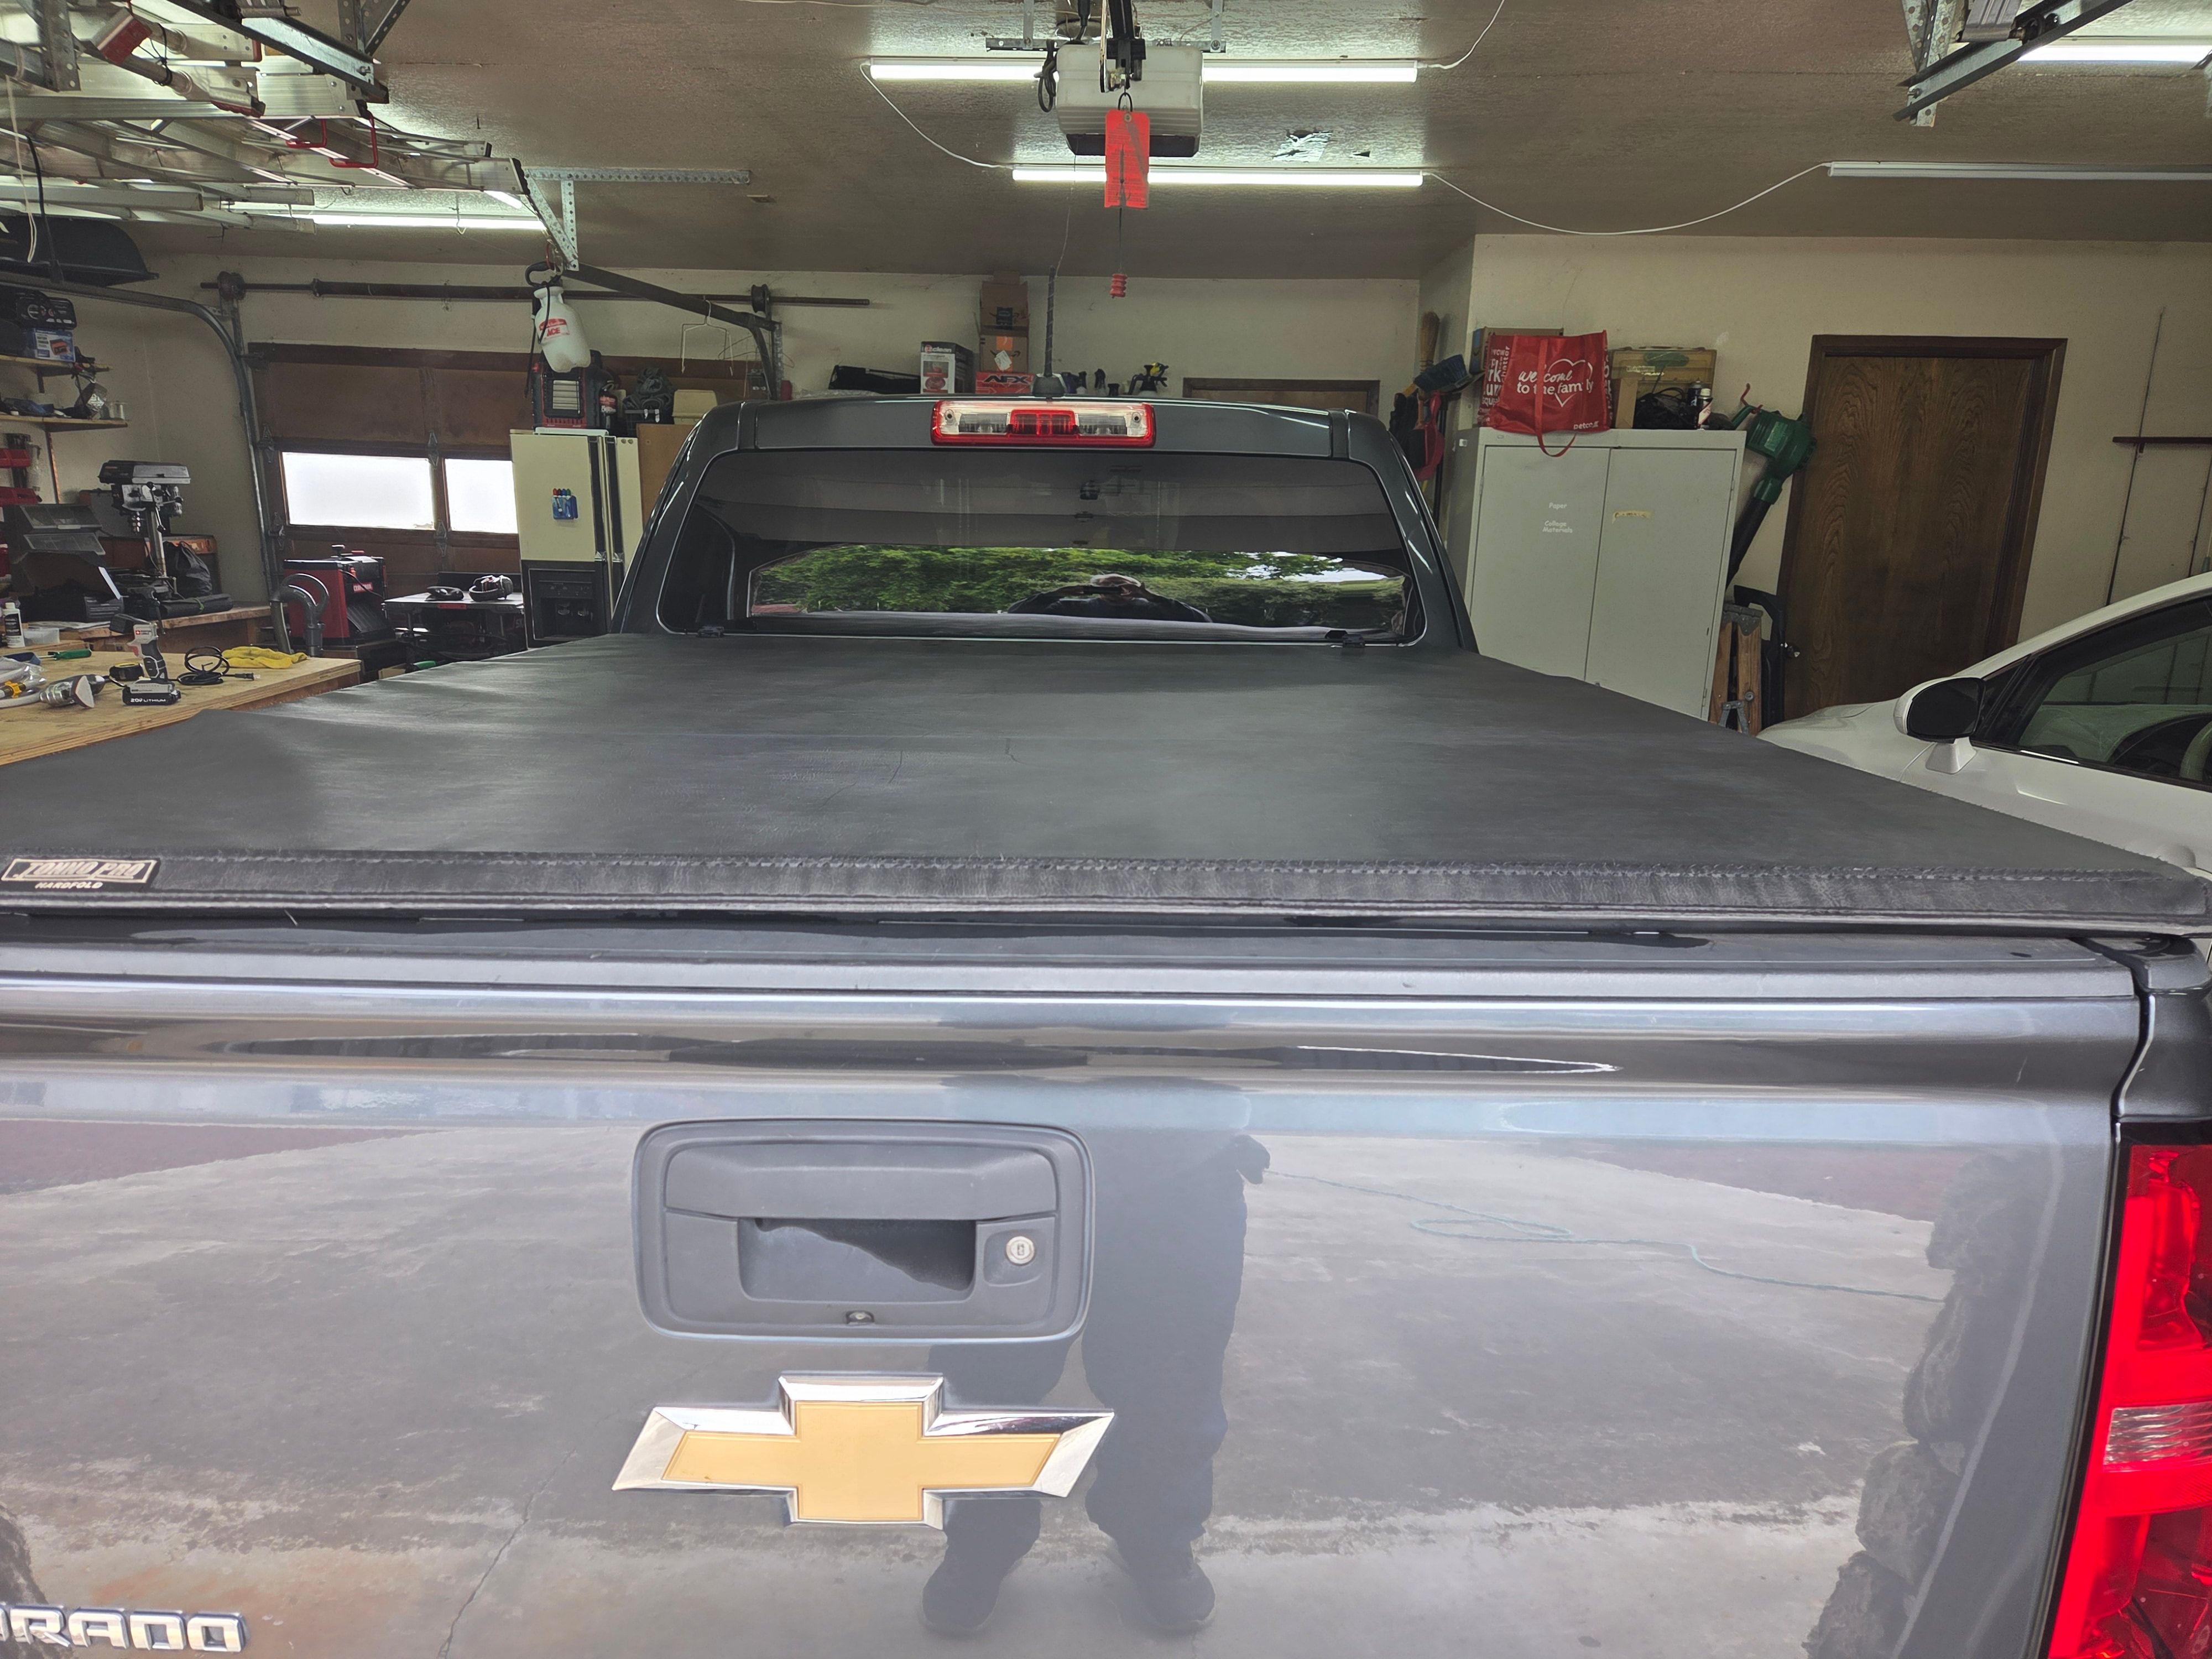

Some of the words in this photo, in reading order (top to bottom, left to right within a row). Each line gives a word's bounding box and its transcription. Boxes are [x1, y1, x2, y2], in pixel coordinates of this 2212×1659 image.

[984, 374, 1029, 383] AFX
[1519, 366, 1572, 383] wecome
[1517, 382, 1530, 394] to
[1557, 378, 1594, 394] famly
[1545, 520, 1567, 529] Collage
[20, 862, 98, 879] TONNO
[89, 863, 145, 879] PRO
[0, 1606, 248, 1653] RADO
